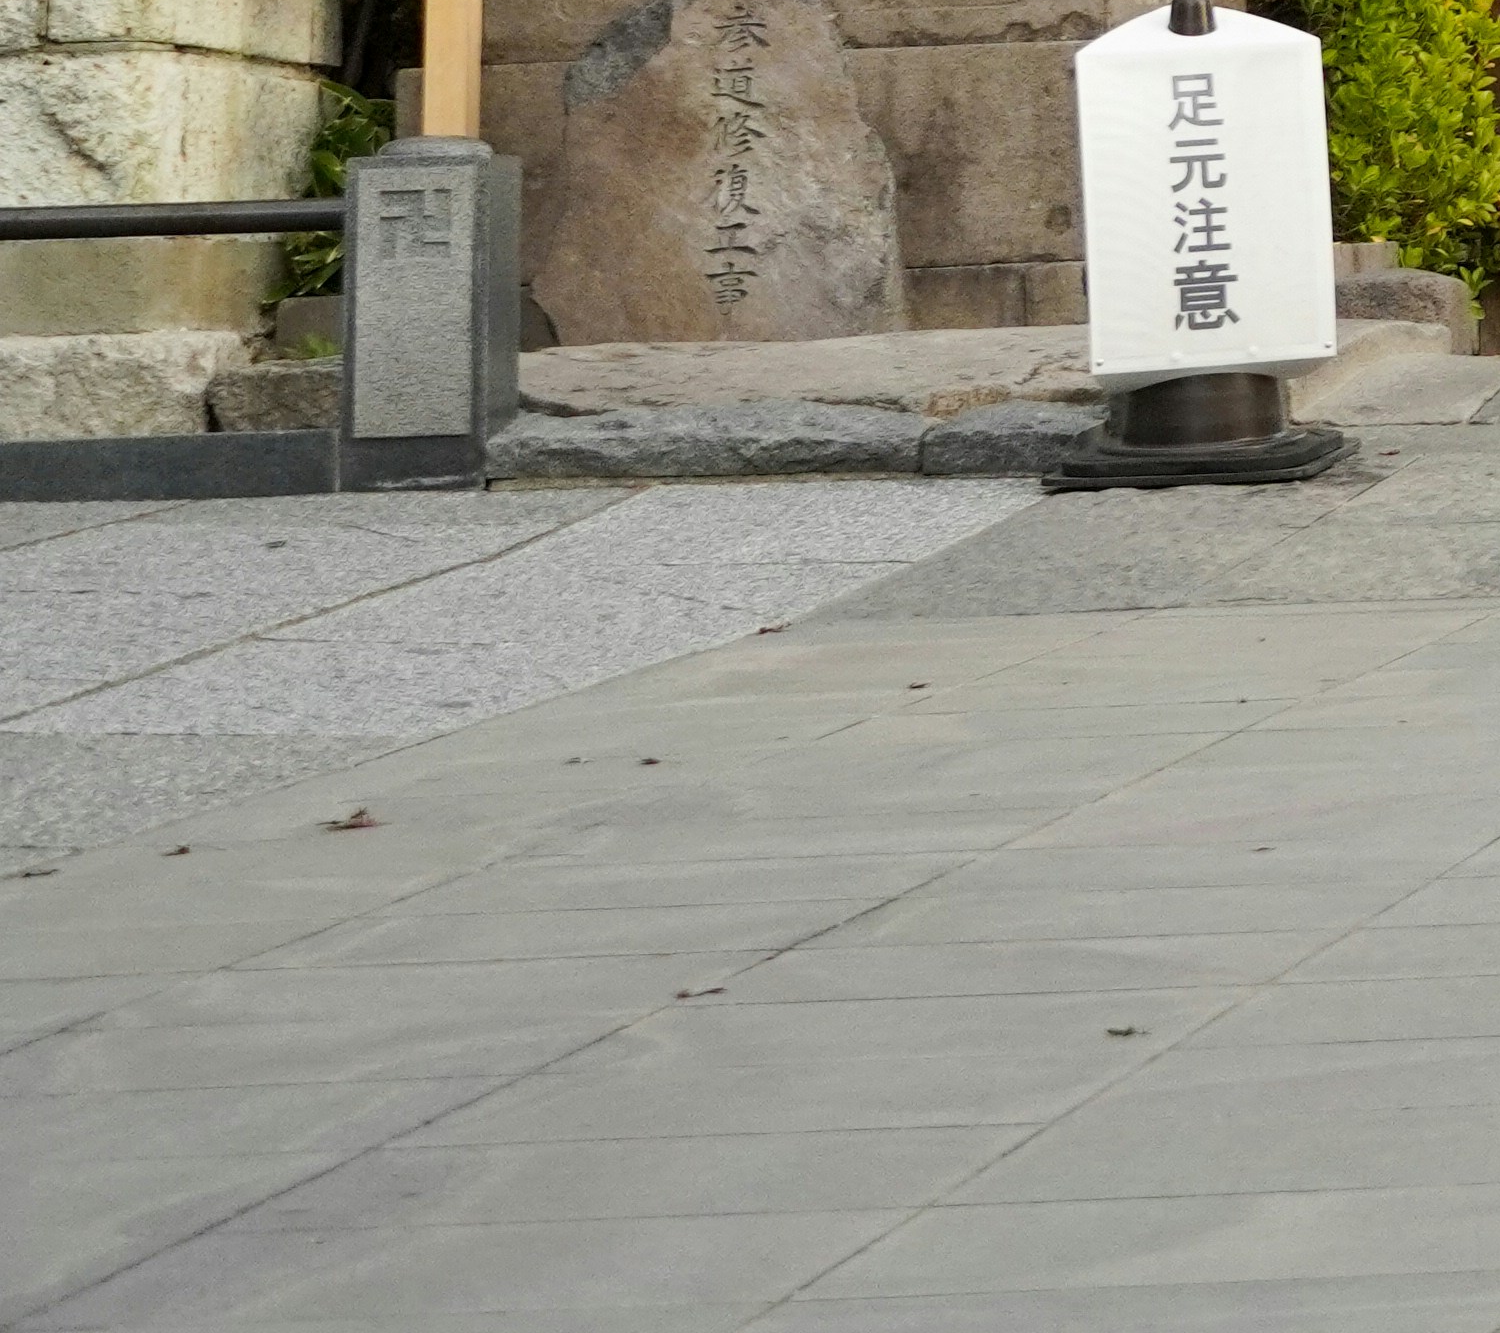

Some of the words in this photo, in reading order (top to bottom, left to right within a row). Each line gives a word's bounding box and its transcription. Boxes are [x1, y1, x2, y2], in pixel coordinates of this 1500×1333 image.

[702, 5, 772, 316] 参道修復工事
[1167, 73, 1240, 331] 足元注意
